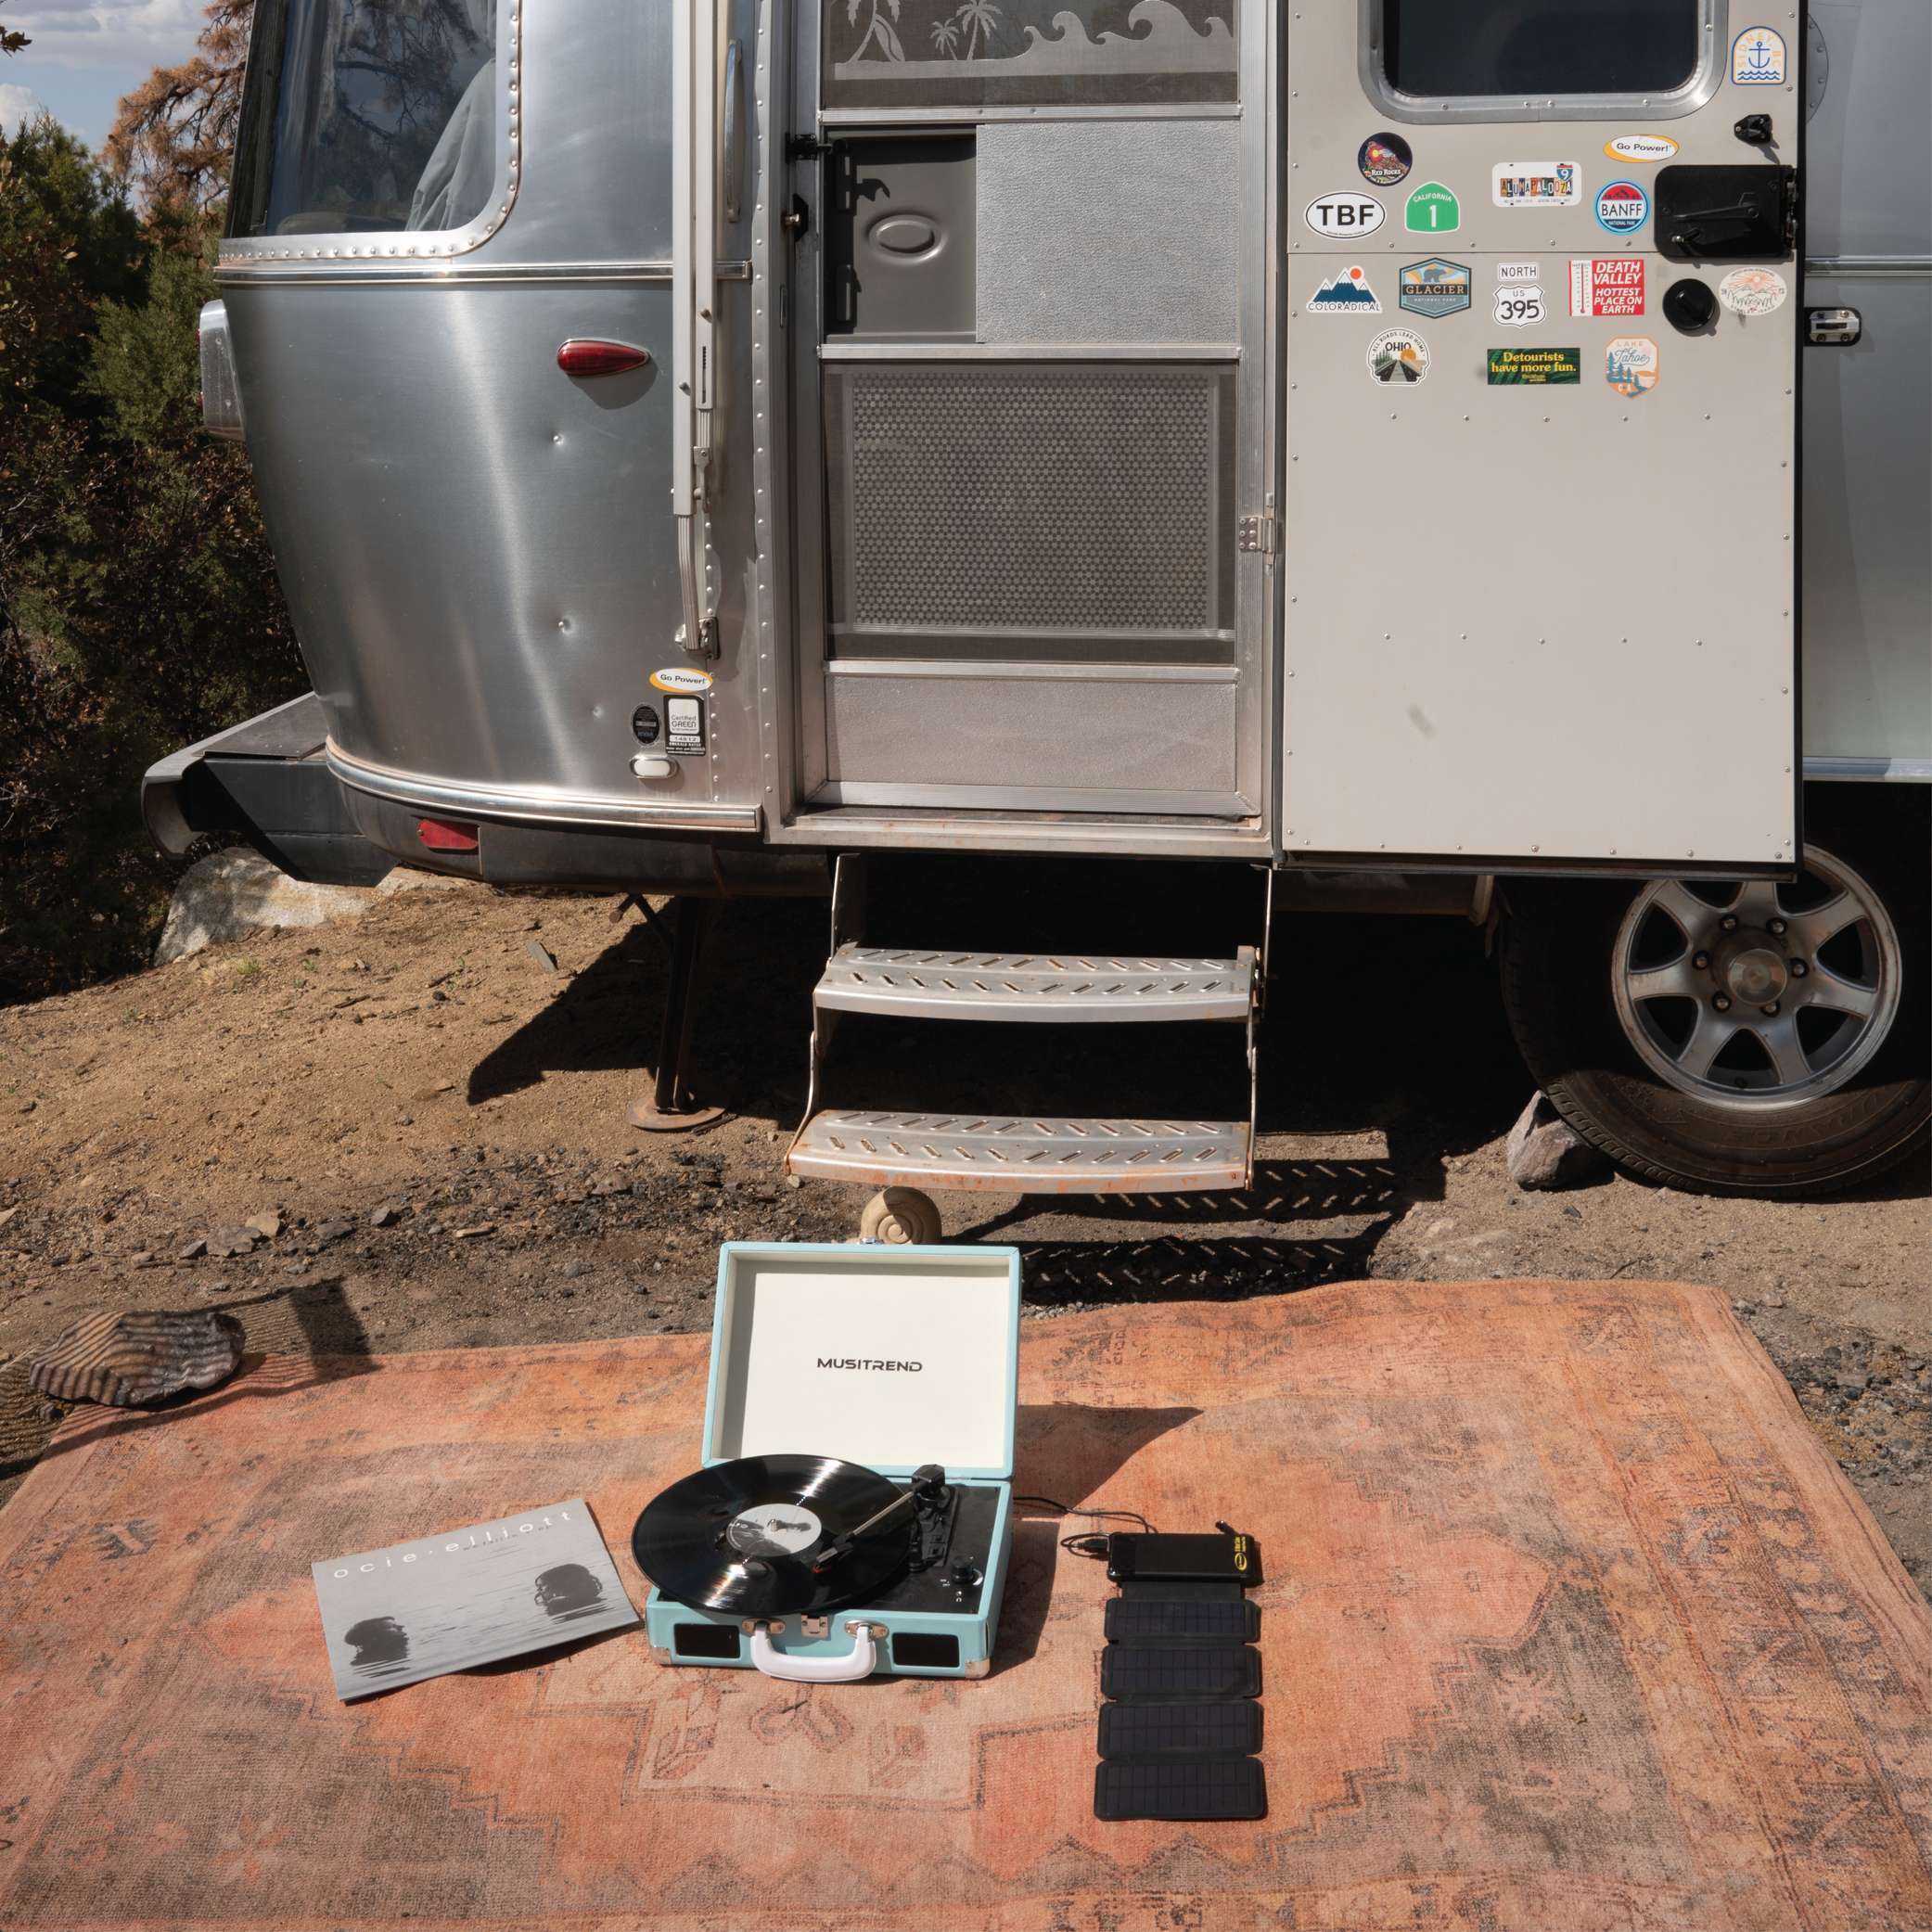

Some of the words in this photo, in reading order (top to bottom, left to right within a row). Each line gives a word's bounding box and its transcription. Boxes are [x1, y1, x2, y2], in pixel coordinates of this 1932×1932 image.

[1633, 144, 1669, 152] Power!
[1560, 169, 1569, 181] 9
[1413, 192, 1452, 203] CALIFORNIA
[1316, 204, 1375, 226] TBF
[1602, 203, 1643, 217] BANFF
[1429, 205, 1437, 228] 1
[1501, 266, 1537, 277] NORTH
[1596, 262, 1641, 274] DEATH
[1593, 273, 1642, 285] VALLEY
[1405, 284, 1465, 295] GLACIER
[1595, 288, 1641, 297] HOTTEST
[1594, 297, 1625, 305] PLACE
[1627, 296, 1643, 305] ON
[1308, 302, 1381, 313] COLORADICAL
[1501, 299, 1540, 320] 395
[1602, 305, 1635, 314] EARTH
[1385, 341, 1412, 352] OHIO
[1503, 352, 1565, 363] Detourists
[1614, 348, 1650, 366] Tahoe
[1491, 362, 1518, 373] have
[1521, 364, 1552, 372] more
[1554, 362, 1577, 372] fun.
[674, 675, 706, 685] Power!
[816, 1358, 923, 1373] MUSITREND
